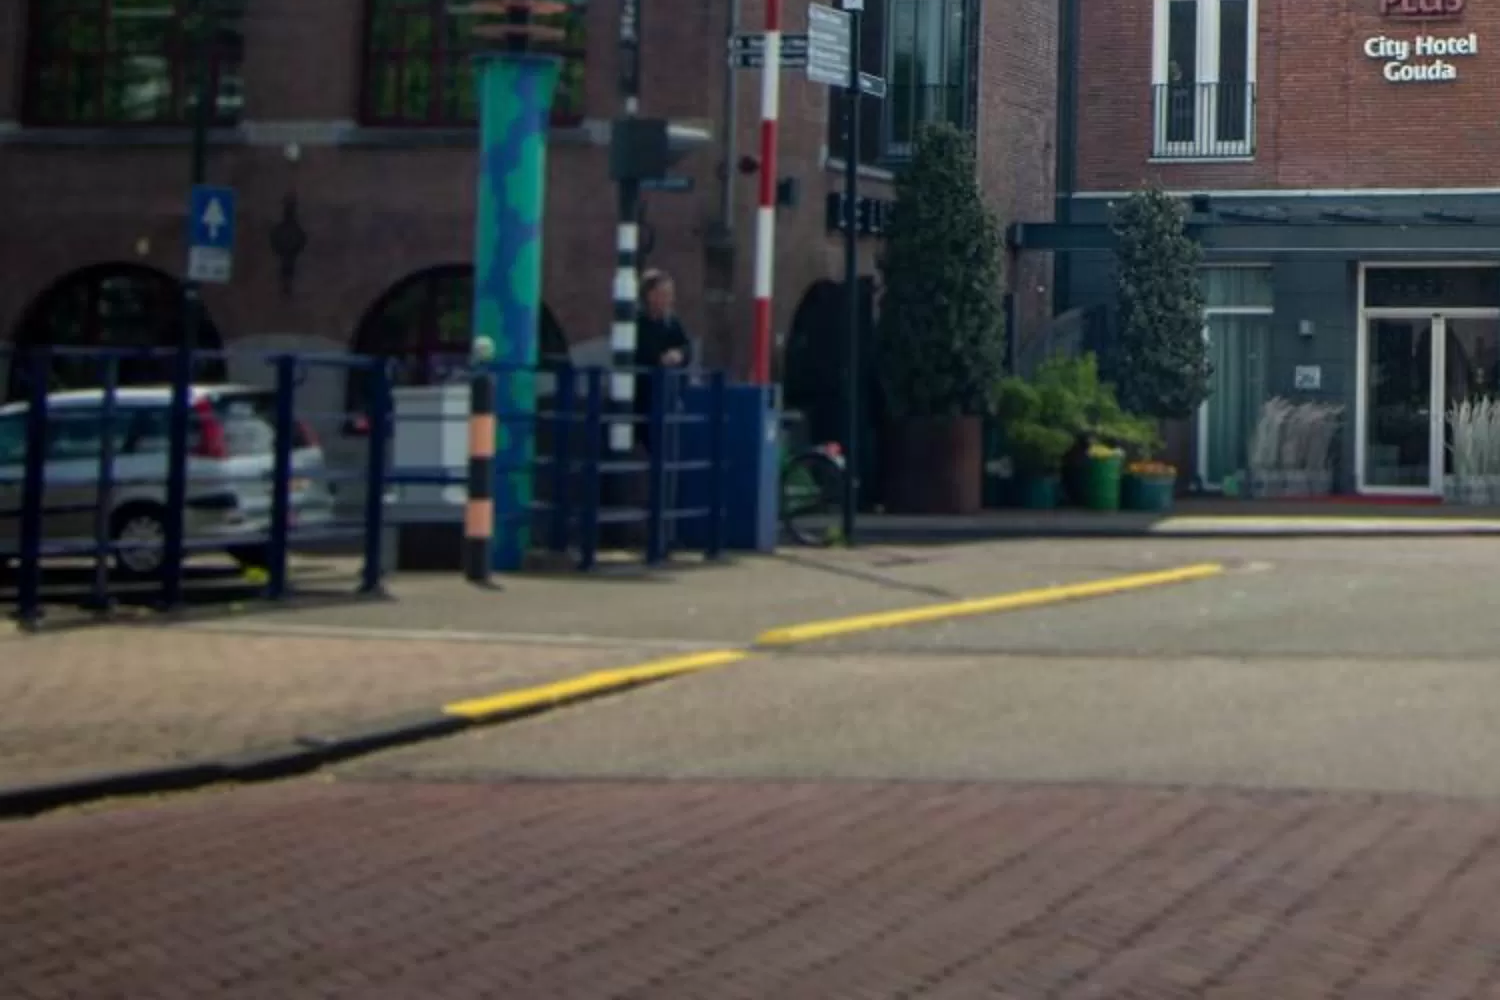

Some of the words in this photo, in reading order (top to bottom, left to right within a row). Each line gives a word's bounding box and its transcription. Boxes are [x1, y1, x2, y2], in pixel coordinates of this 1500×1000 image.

[1364, 37, 1409, 59] City
[1415, 33, 1478, 55] Hotel
[1383, 60, 1456, 81] Gouda
